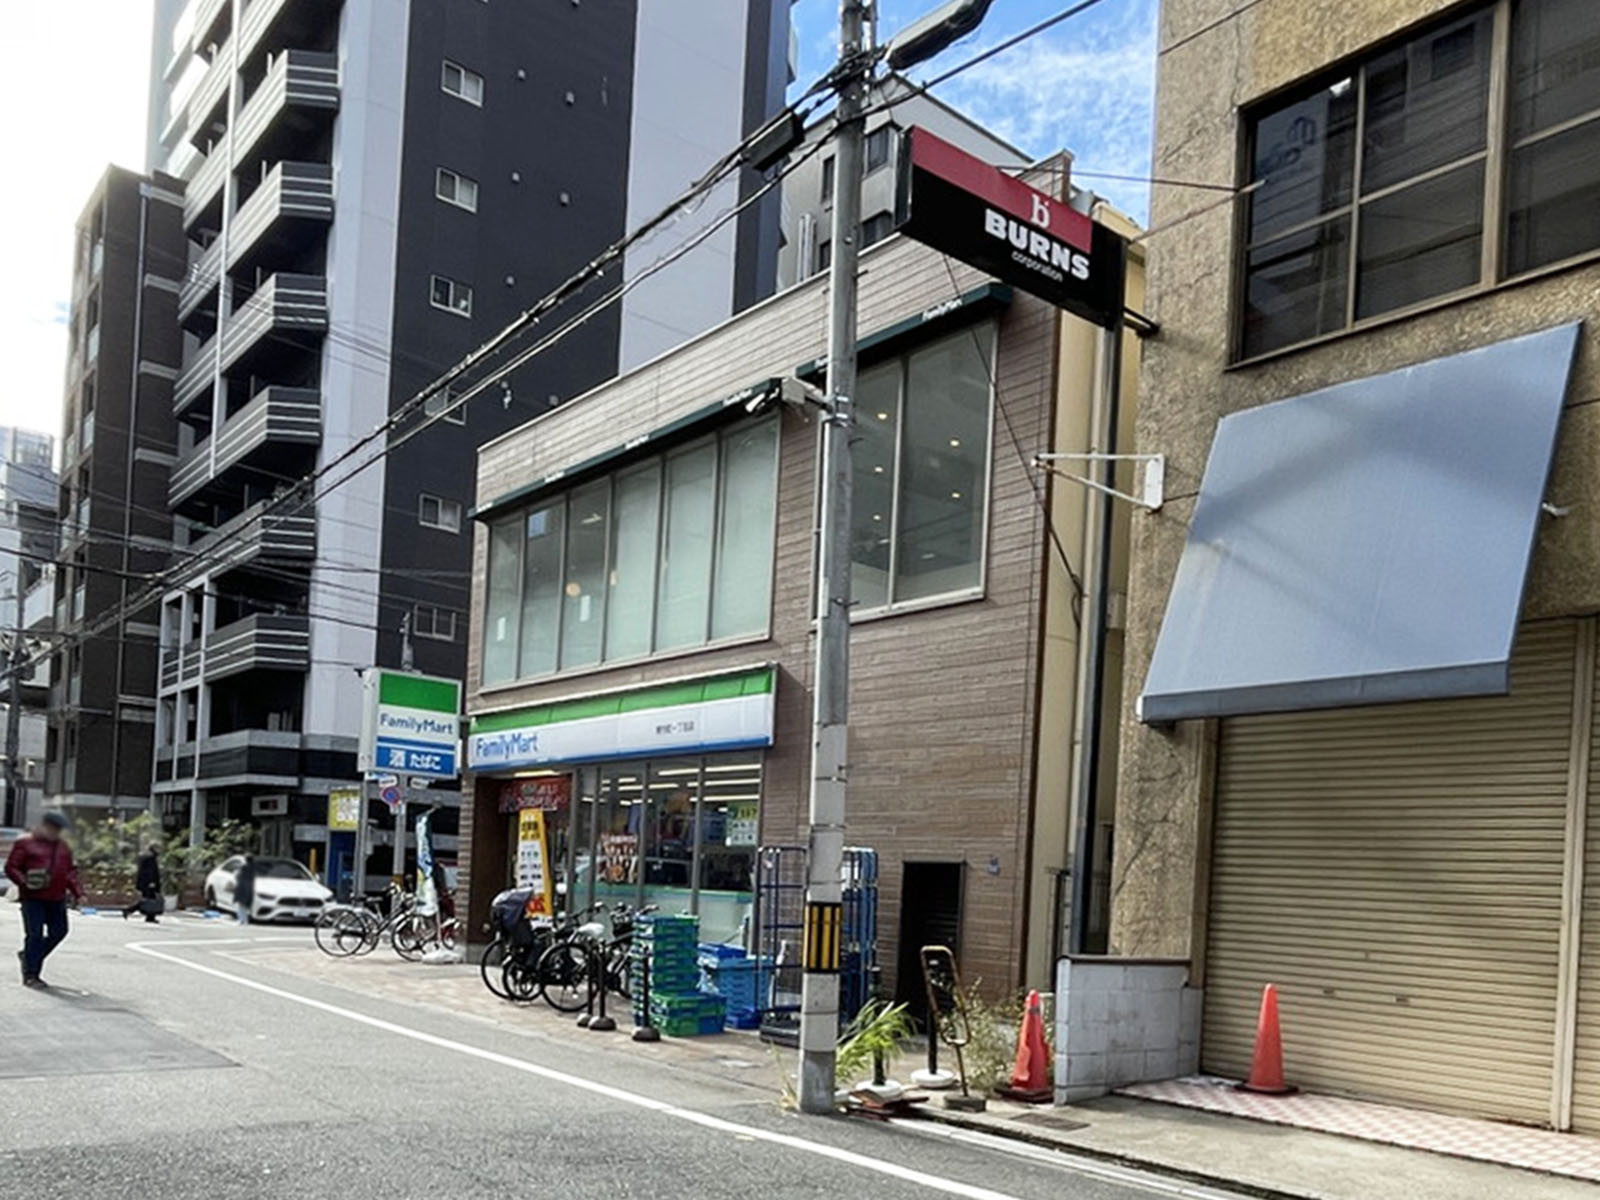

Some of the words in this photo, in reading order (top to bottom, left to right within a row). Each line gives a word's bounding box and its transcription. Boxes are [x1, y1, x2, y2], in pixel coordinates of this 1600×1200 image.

[985, 208, 1090, 280] BURNS
[1011, 250, 1063, 283] corporation
[380, 712, 453, 735] FamilyMart
[476, 733, 538, 760] FamilyMart
[410, 753, 442, 771] たばこ
